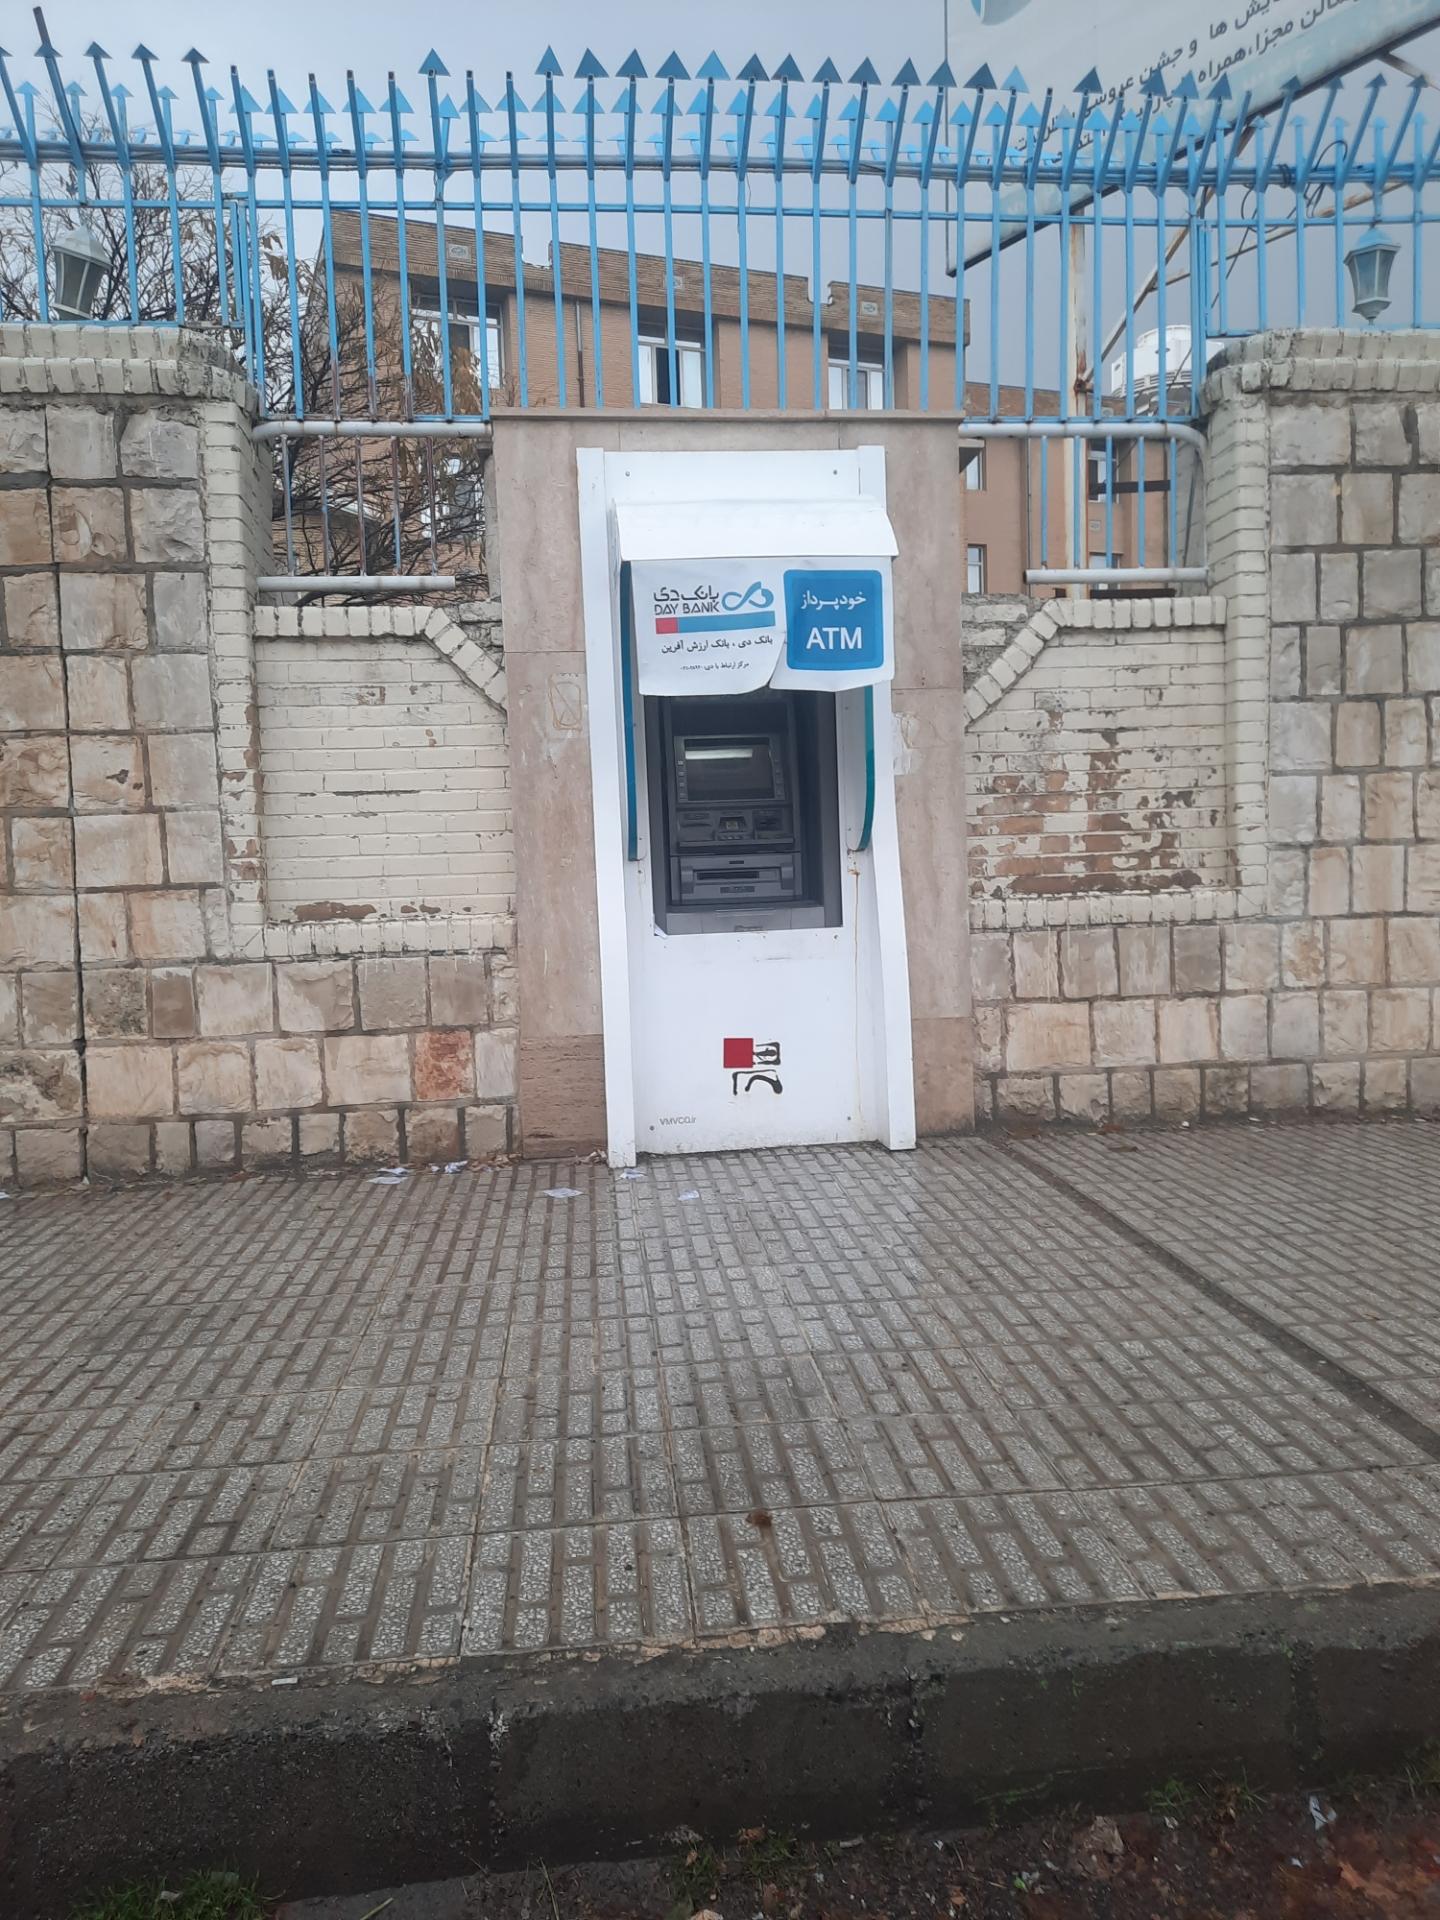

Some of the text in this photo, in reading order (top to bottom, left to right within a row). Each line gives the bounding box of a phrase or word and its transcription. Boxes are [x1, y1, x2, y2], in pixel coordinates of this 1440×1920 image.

[1209, 21, 1228, 40] ها
[1188, 38, 1198, 59] و
[653, 585, 720, 603] بانک دی
[654, 601, 720, 616] DAY BANK
[711, 638, 730, 650] بانک
[738, 639, 752, 649] دی
[754, 634, 773, 646] بانک
[805, 626, 863, 650] ATM
[661, 639, 684, 654] آفرین
[687, 639, 709, 653] ارزش
